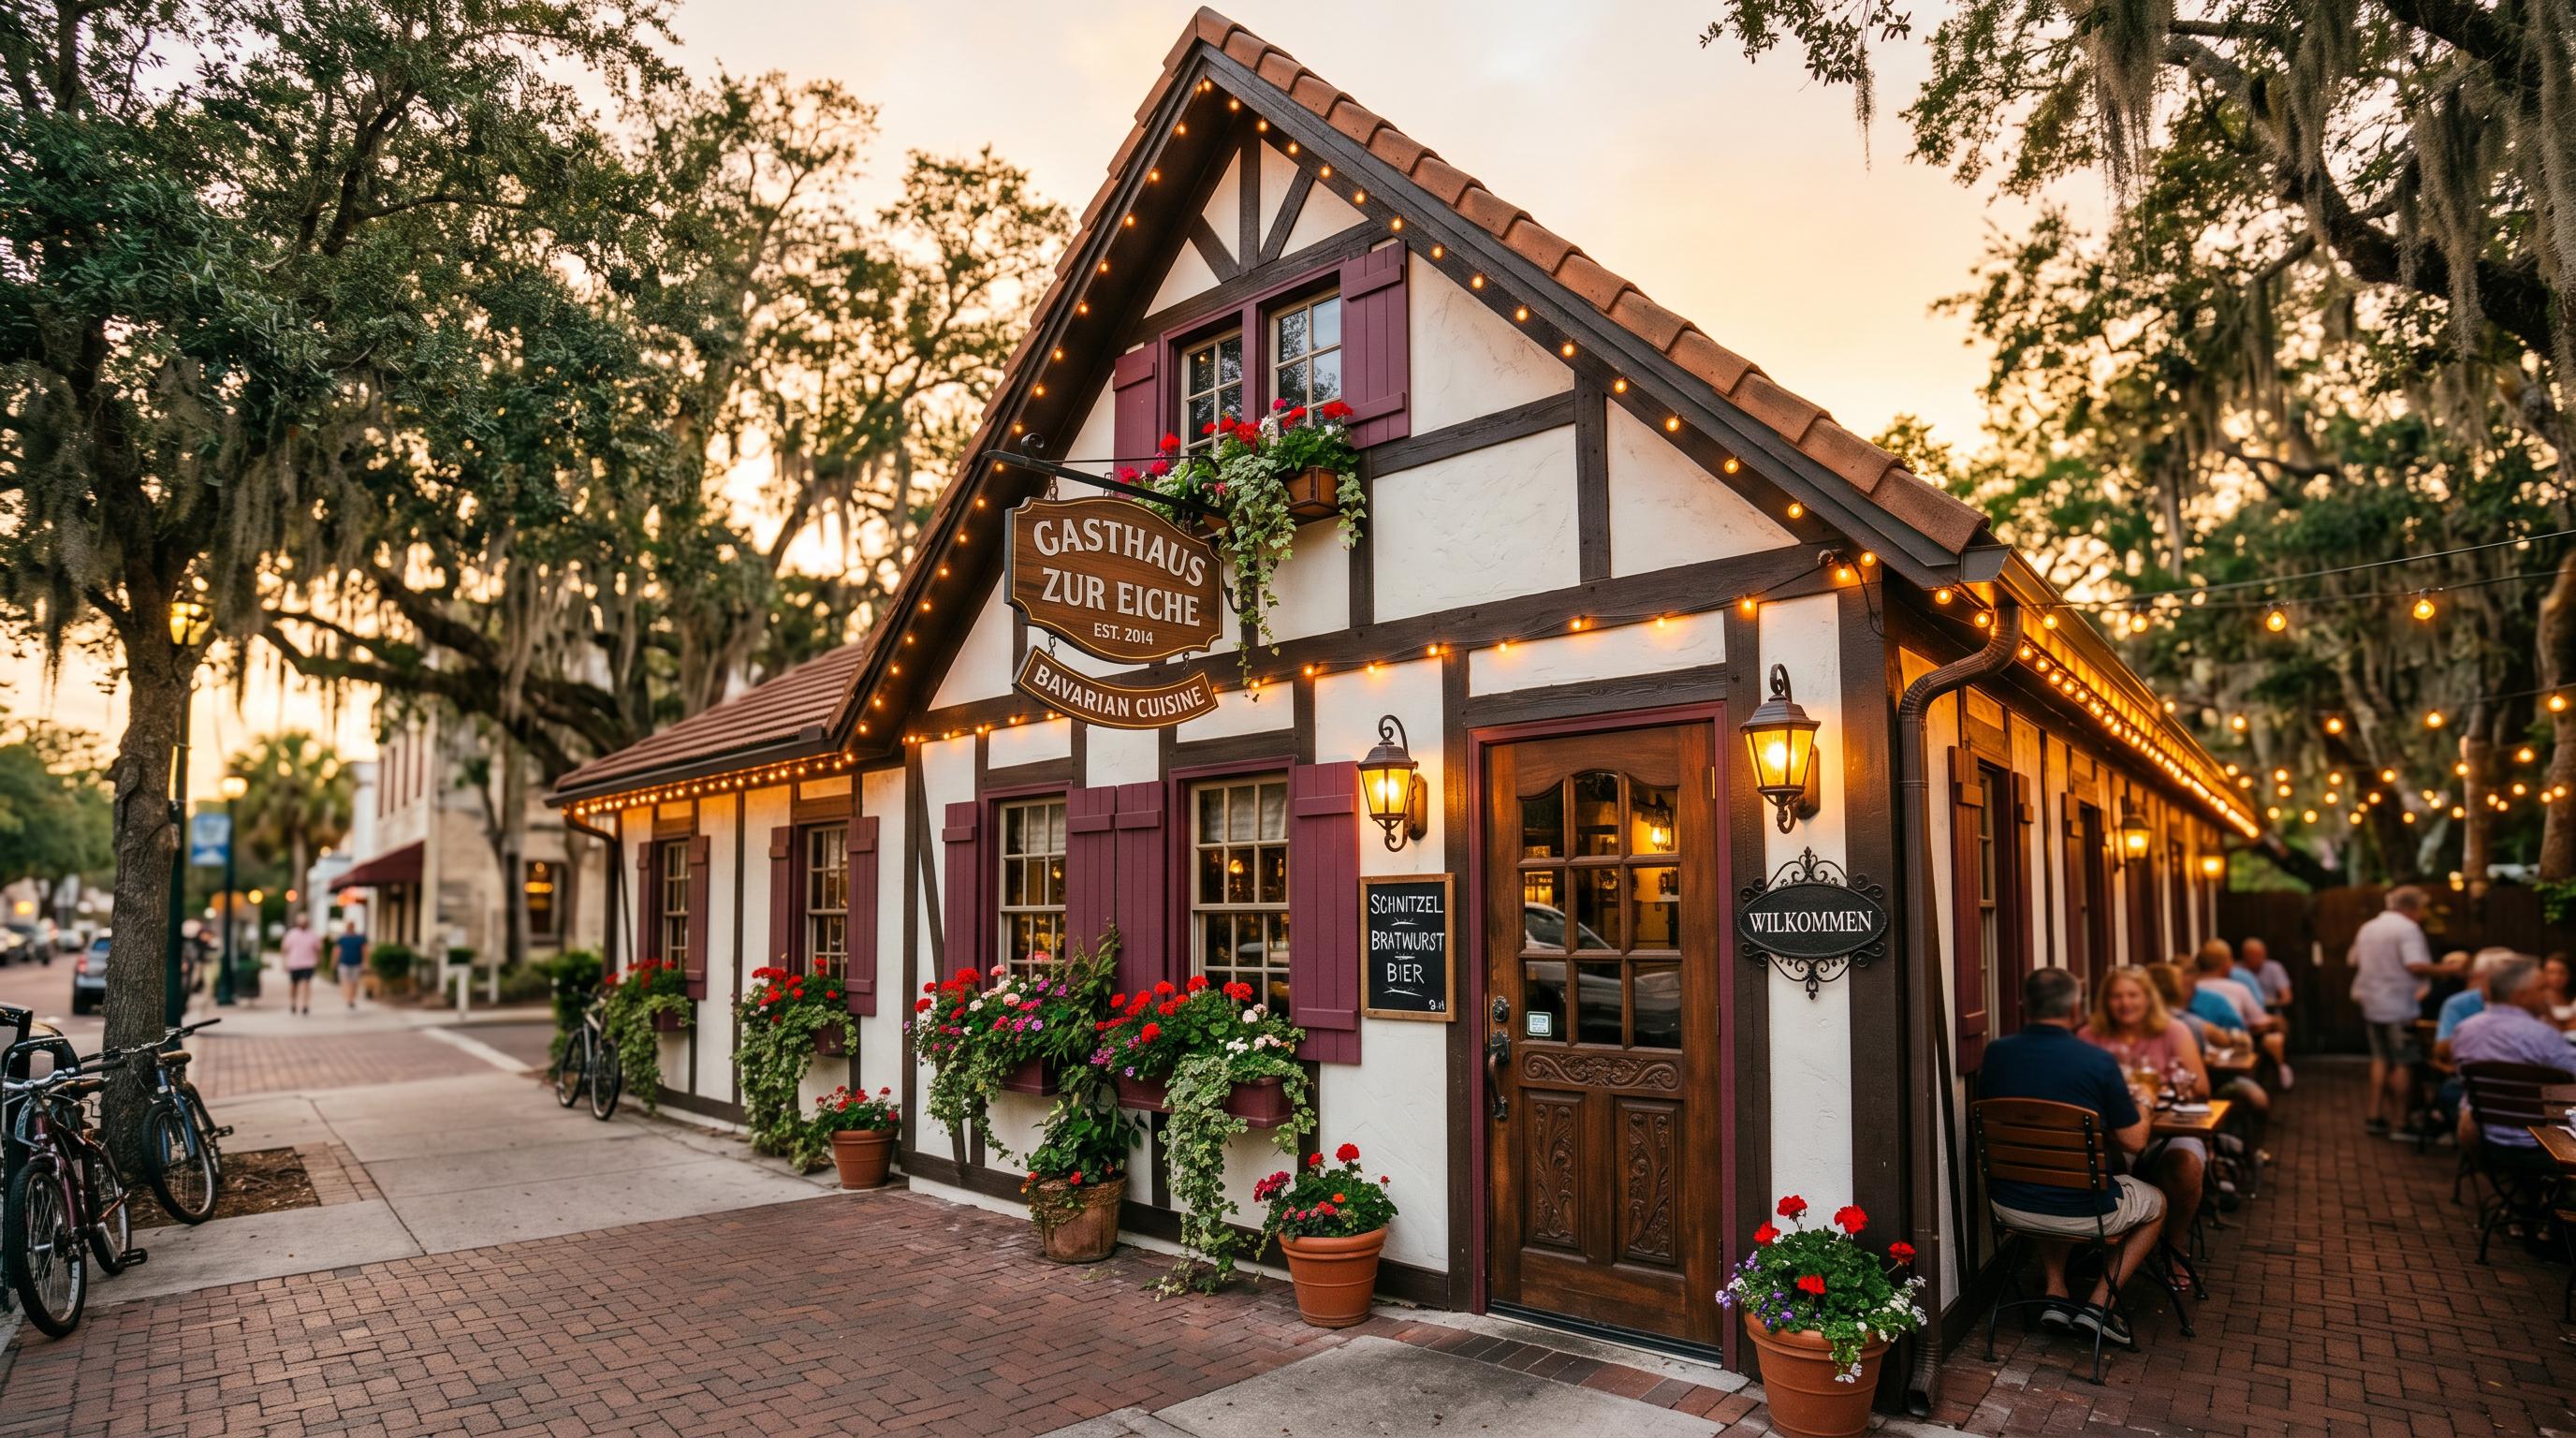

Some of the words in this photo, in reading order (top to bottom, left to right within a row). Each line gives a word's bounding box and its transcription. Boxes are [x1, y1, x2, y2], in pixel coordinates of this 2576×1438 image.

[1033, 518, 1206, 587] GASTHAUS
[1041, 566, 1106, 611] ZUR
[1117, 580, 1201, 627] EICHE
[1093, 622, 1120, 640] EST.
[1124, 627, 1154, 645] 2014
[1032, 664, 1130, 718] BAVARIAN
[1135, 685, 1206, 718] CUISINE
[1370, 893, 1444, 915] SCHNITZEL
[1749, 910, 1873, 933] WILKOMMEN
[1371, 930, 1445, 952] BRATWURST
[1386, 962, 1425, 984] BIER
